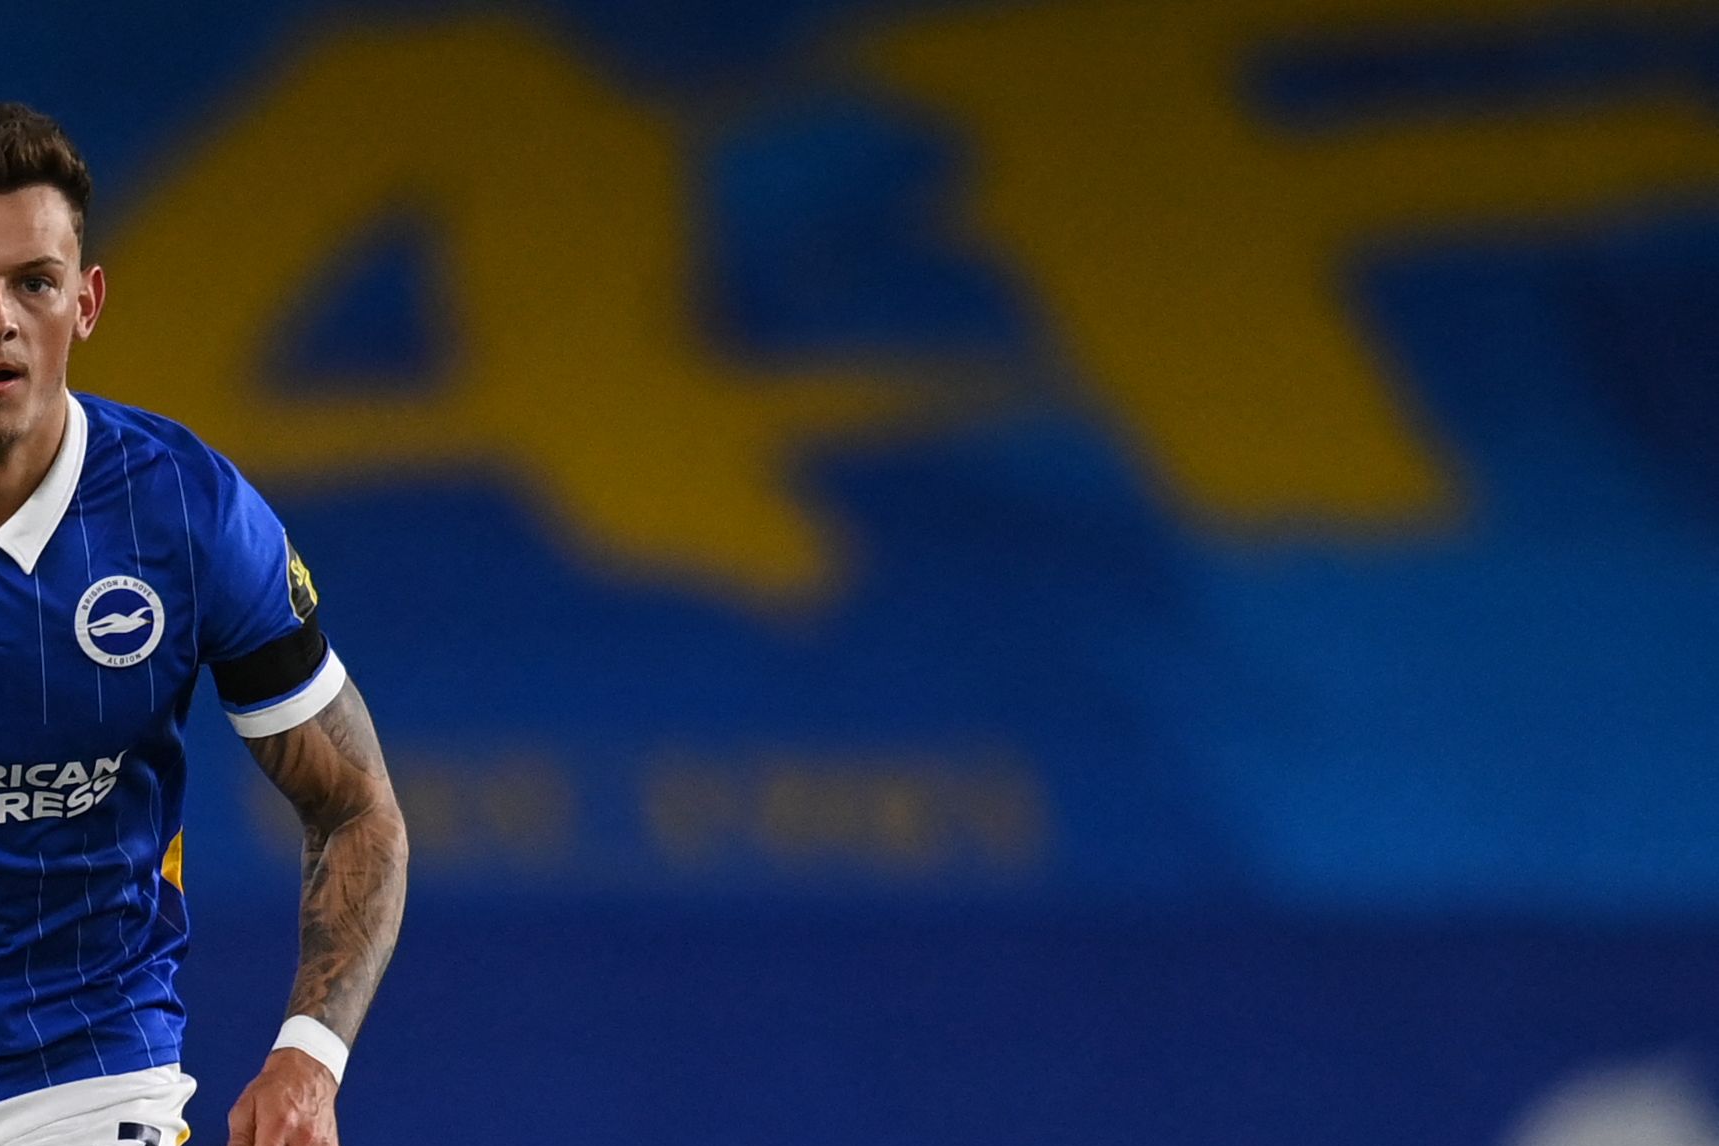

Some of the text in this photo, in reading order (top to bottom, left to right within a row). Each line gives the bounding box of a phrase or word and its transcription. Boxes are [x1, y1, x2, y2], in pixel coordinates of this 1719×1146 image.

[81, 579, 119, 611] BRIGHTON
[131, 581, 154, 598] HOVE
[105, 652, 143, 666] ALBION
